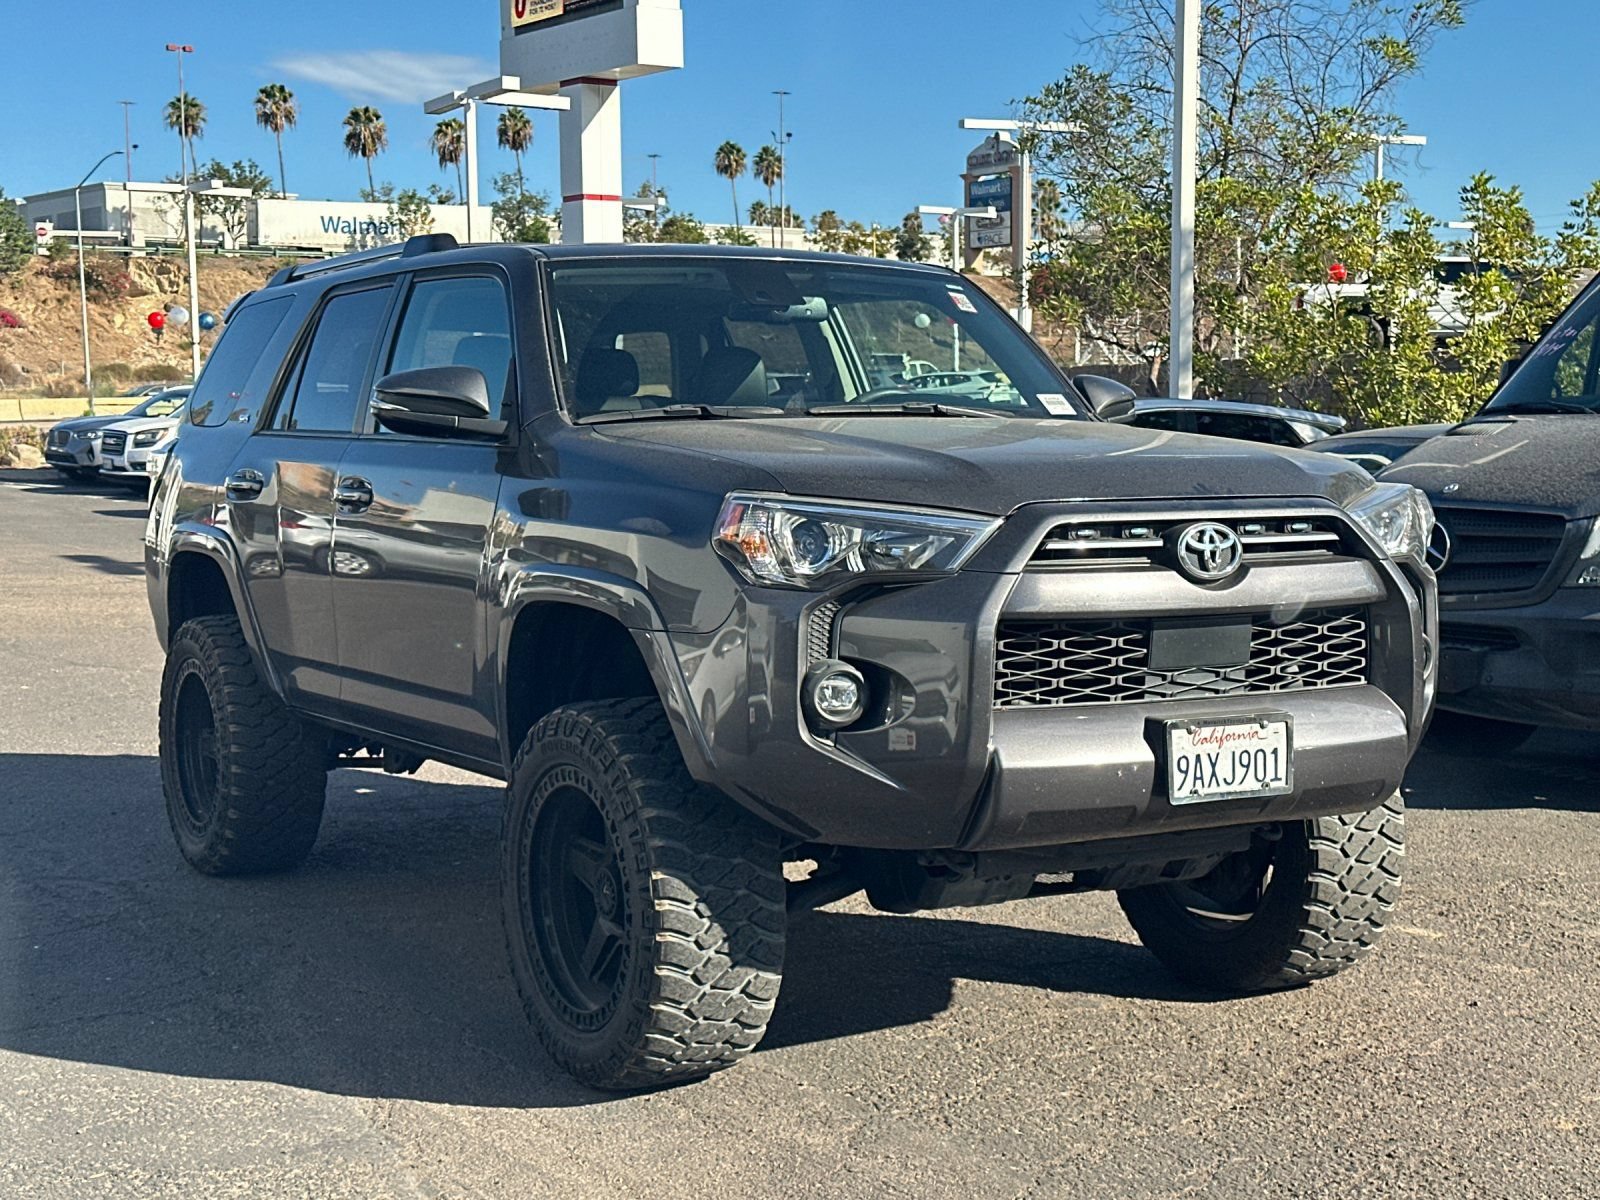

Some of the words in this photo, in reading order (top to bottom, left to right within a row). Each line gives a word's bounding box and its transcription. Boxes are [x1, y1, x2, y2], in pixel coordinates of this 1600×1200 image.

[970, 182, 1001, 196] Walmart
[320, 215, 401, 235] Walmar
[1192, 726, 1268, 750] California
[1177, 747, 1282, 791] 9AXJ901
